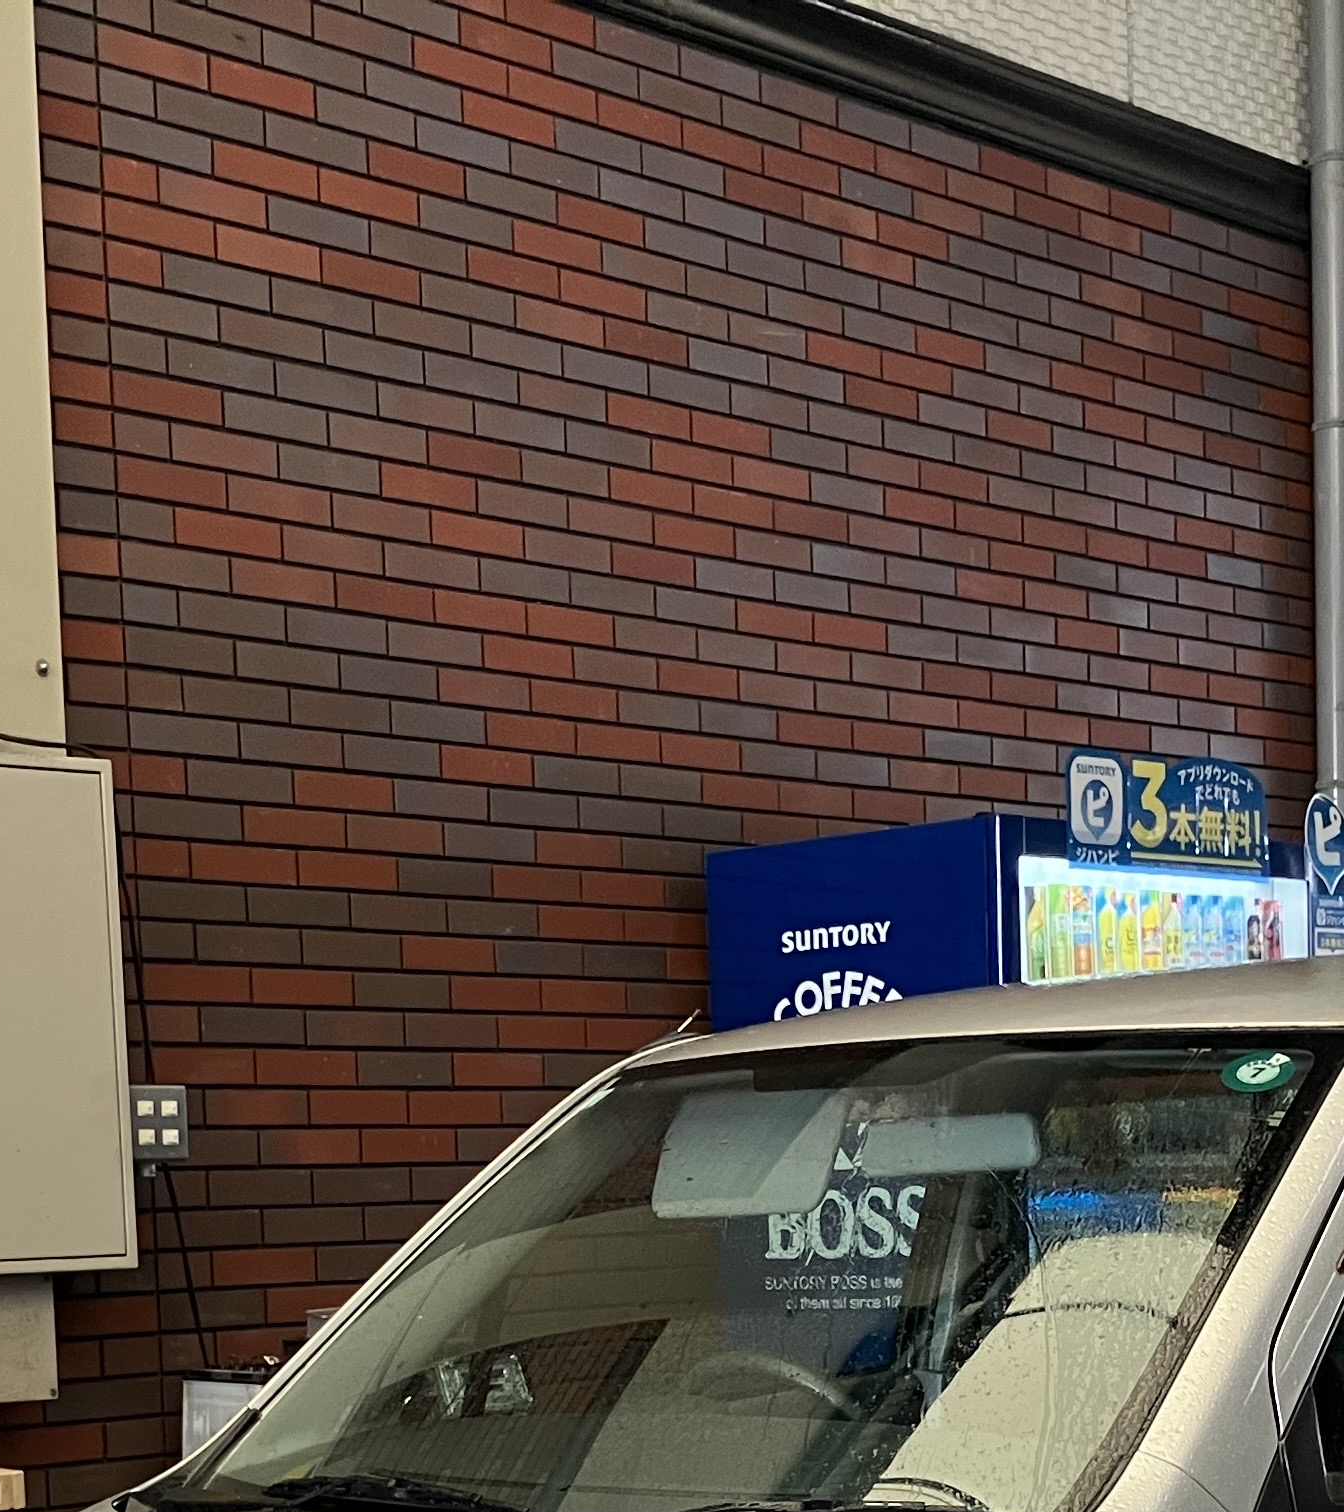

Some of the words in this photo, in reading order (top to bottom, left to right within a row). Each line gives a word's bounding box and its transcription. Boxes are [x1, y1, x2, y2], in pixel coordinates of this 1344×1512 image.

[1177, 764, 1254, 793] アプリダウンロード
[1195, 783, 1240, 805] でどれでも
[781, 920, 891, 954] SUNTORY
[830, 1275, 867, 1290] BOSS
[870, 1277, 881, 1289] is
[800, 1296, 830, 1310] them
[849, 1296, 881, 1310] since
